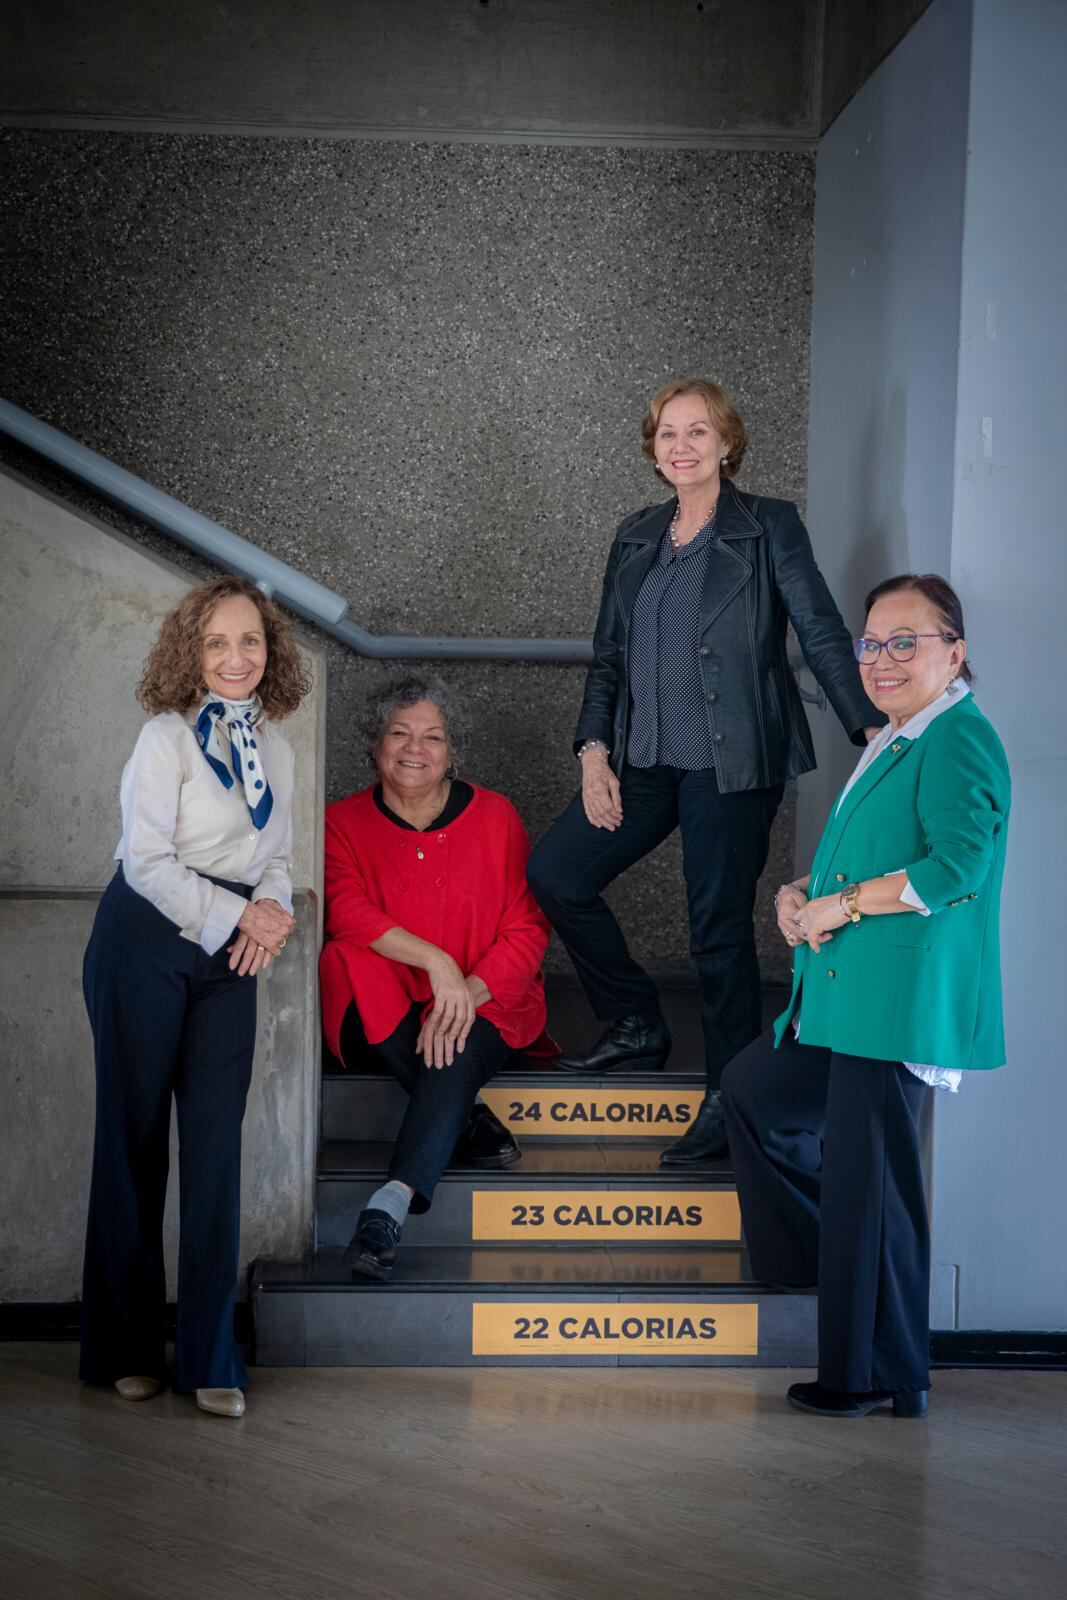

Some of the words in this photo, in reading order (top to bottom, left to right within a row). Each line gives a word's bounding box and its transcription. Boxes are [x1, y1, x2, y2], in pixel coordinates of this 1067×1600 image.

[508, 1102, 542, 1121] 24
[550, 1103, 691, 1123] CALORIAS
[511, 1205, 545, 1226] 23
[553, 1205, 703, 1226] CALORIAS
[513, 1317, 549, 1339] 22
[558, 1317, 717, 1339] CALORIAS
